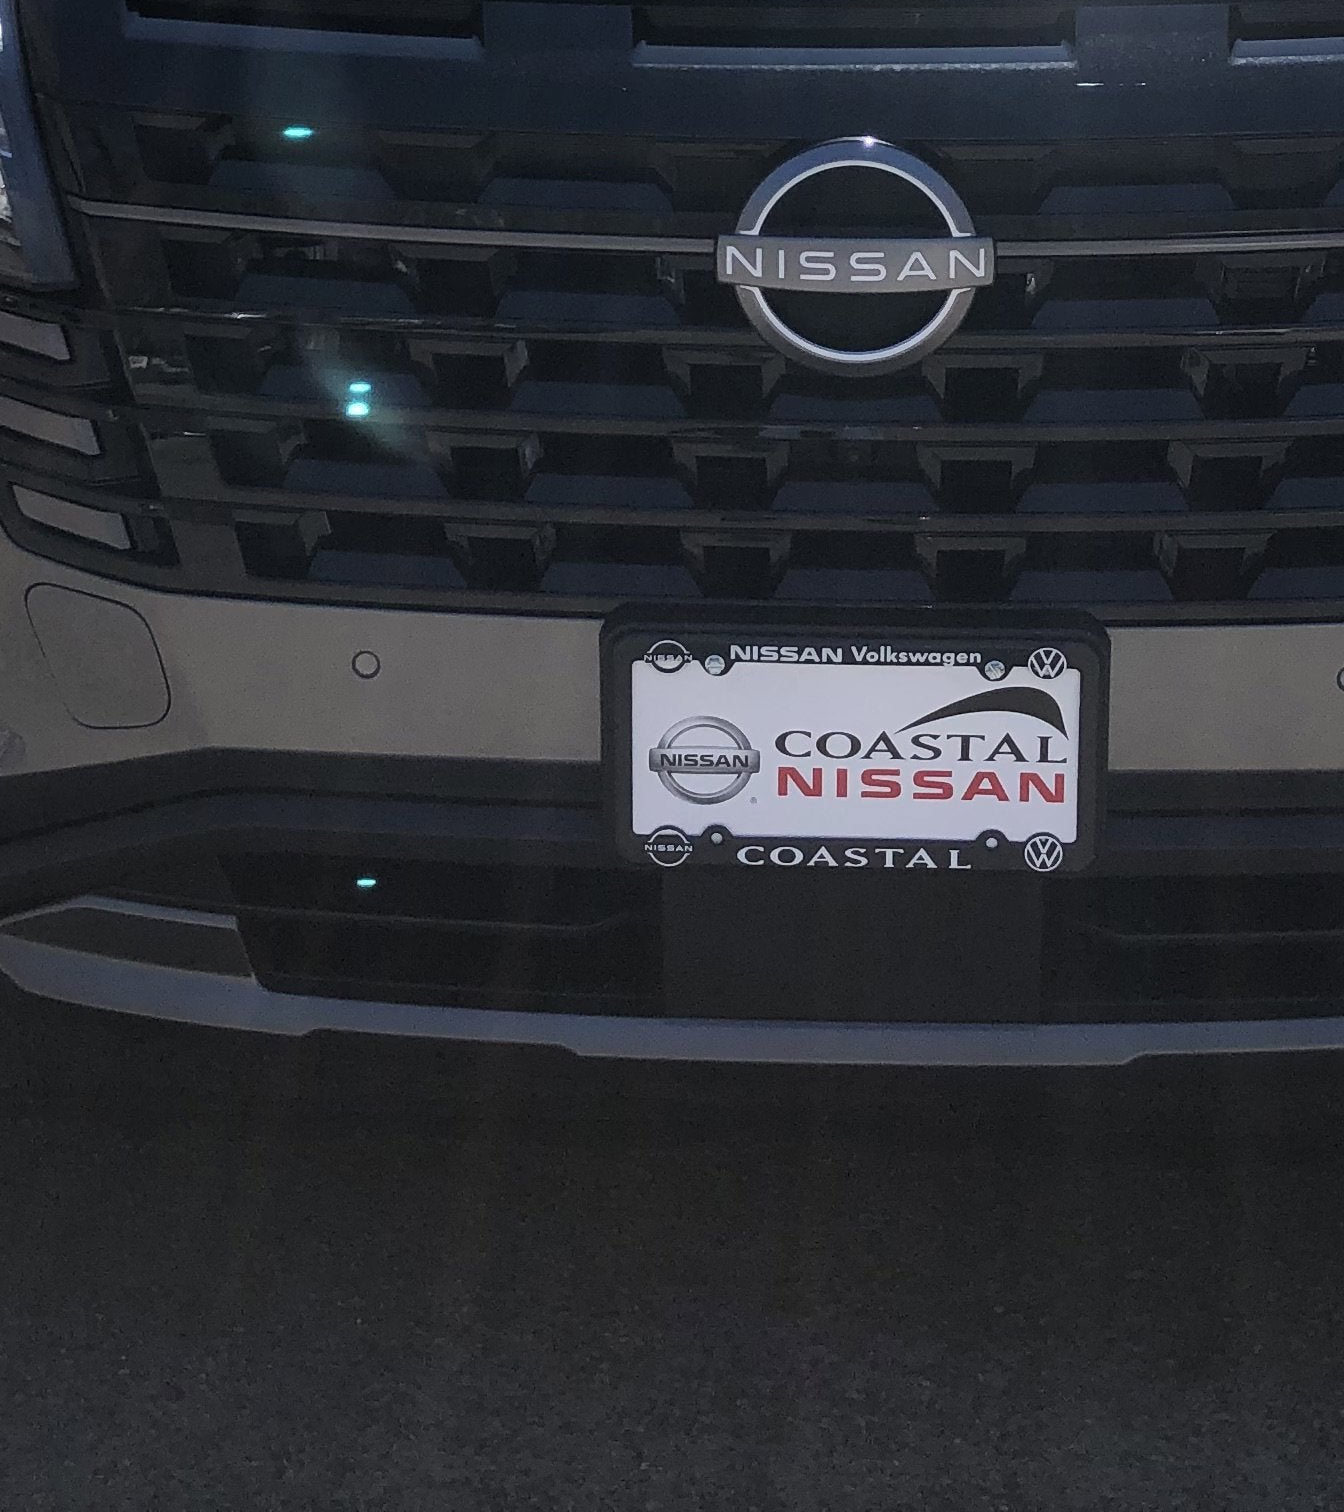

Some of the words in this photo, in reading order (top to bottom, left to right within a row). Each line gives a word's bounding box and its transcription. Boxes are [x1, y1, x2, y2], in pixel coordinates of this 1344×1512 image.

[726, 245, 985, 282] NISSAN
[643, 654, 693, 663] NISSAN
[730, 645, 843, 663] NISSAN
[851, 645, 982, 666] Volkswagen
[774, 730, 1068, 764] COASTAL
[660, 753, 749, 768] NISSAN
[777, 766, 1065, 803] NISSAN
[644, 844, 693, 852] NISSAN
[736, 845, 972, 870] COASTAL
